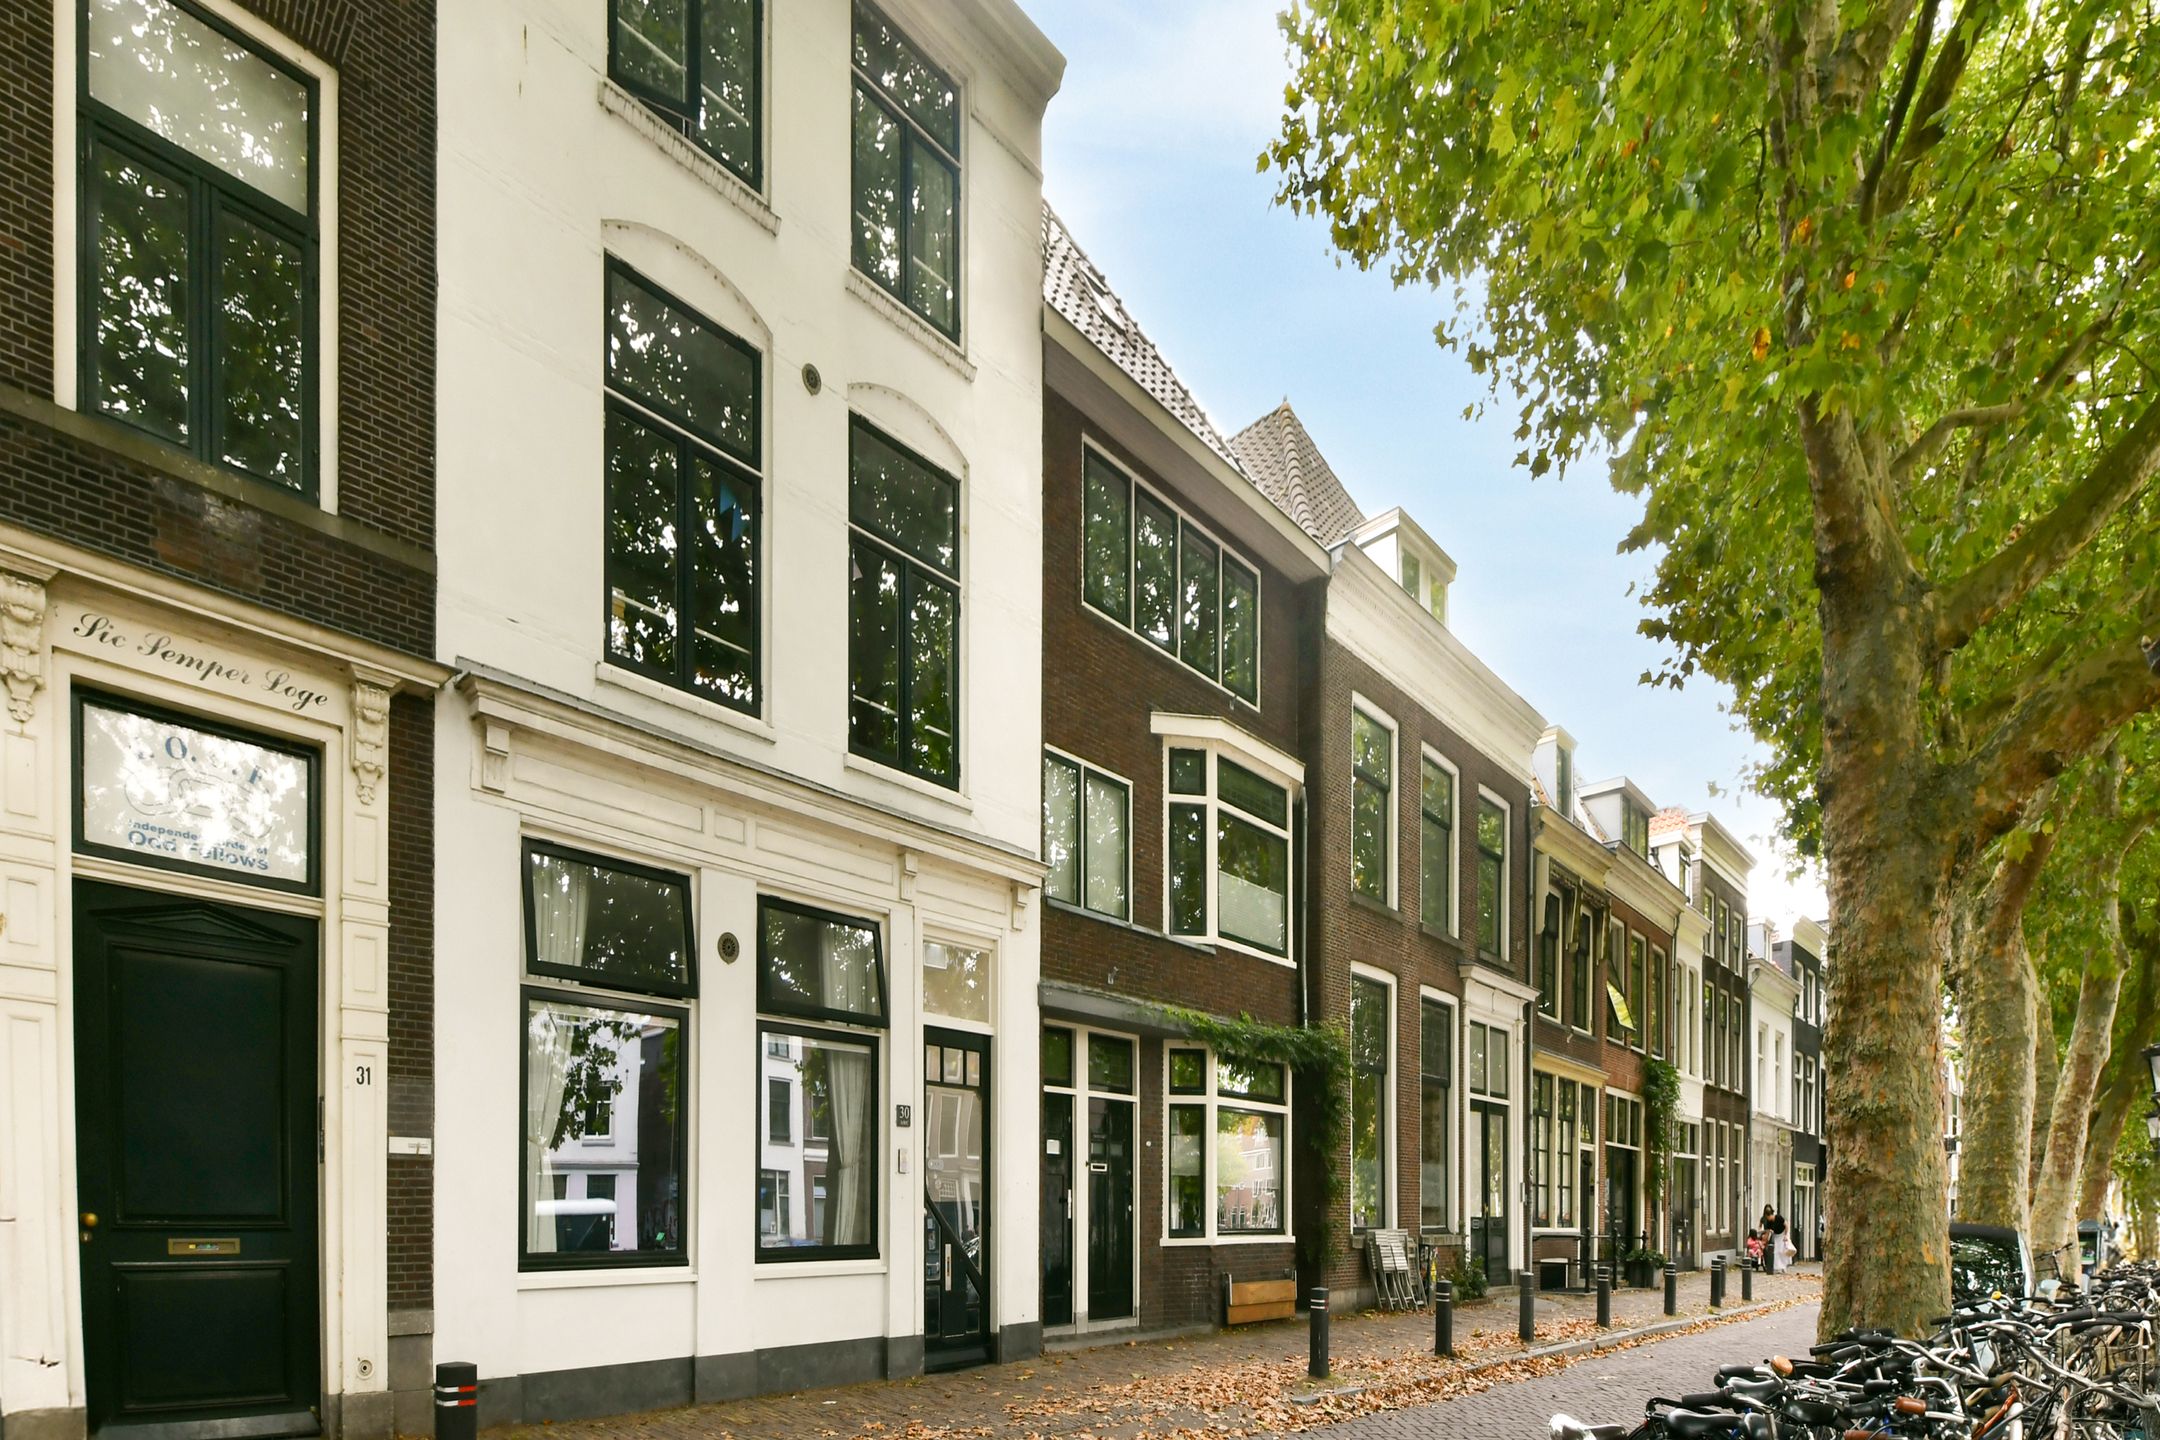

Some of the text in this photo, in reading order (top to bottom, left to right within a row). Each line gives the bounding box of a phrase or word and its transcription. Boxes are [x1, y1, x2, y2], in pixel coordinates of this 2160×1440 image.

[73, 612, 328, 711] Sic Semper Loge
[356, 1066, 371, 1086] 31
[899, 1106, 910, 1120] 30
